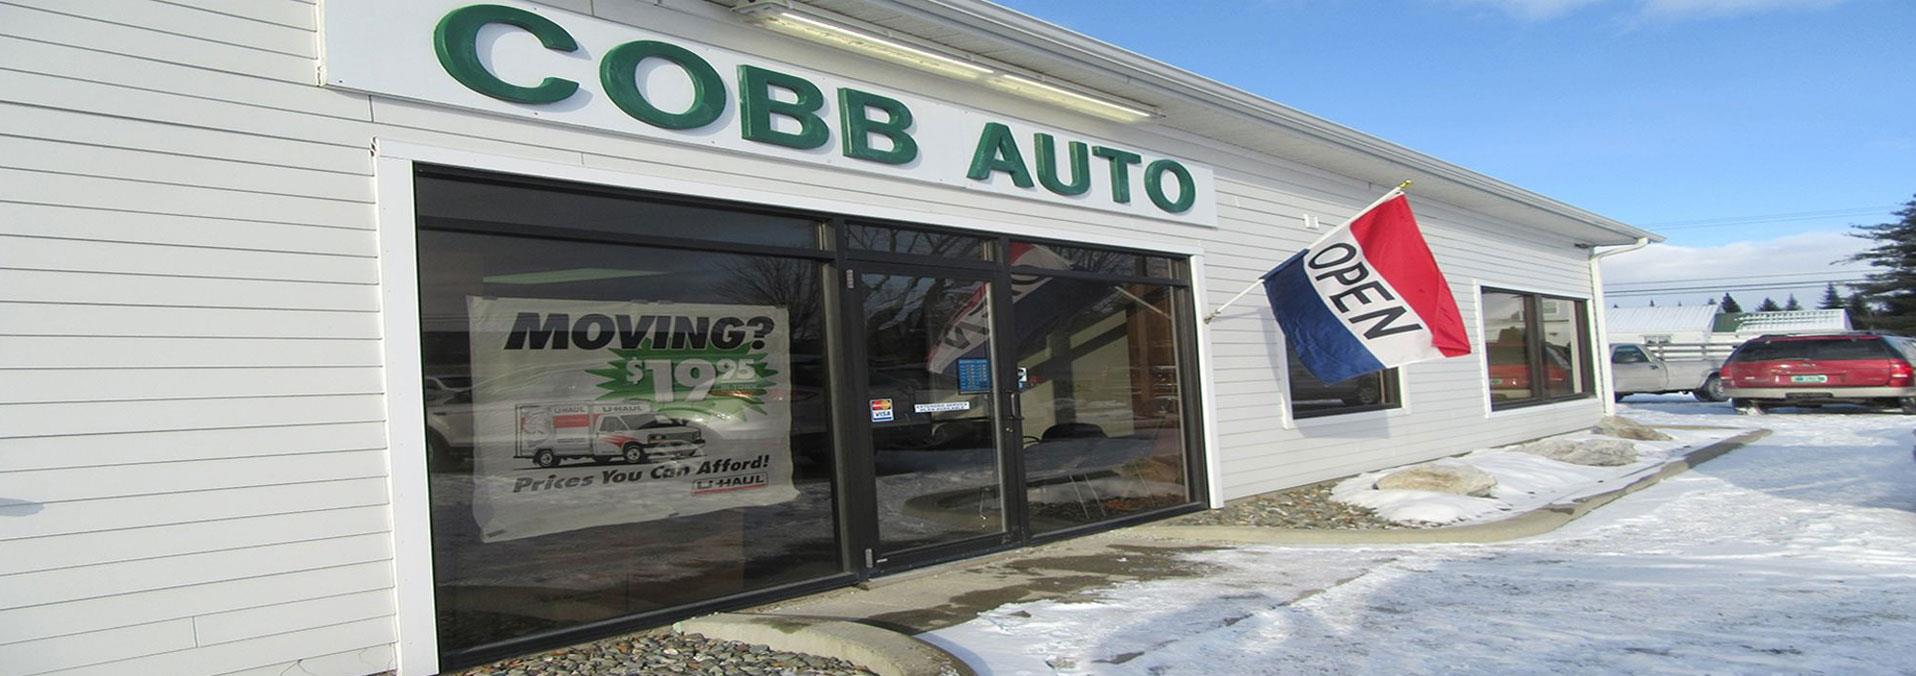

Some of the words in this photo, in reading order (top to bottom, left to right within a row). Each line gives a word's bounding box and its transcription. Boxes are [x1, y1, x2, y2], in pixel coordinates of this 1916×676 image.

[433, 3, 919, 165] COBB
[966, 121, 1196, 214] AUTO
[1307, 242, 1423, 340] OPEN
[503, 311, 775, 350] MOVING?
[513, 474, 594, 493] Prices
[602, 469, 643, 484] You
[650, 464, 690, 479] Can
[696, 455, 770, 475] Afford!
